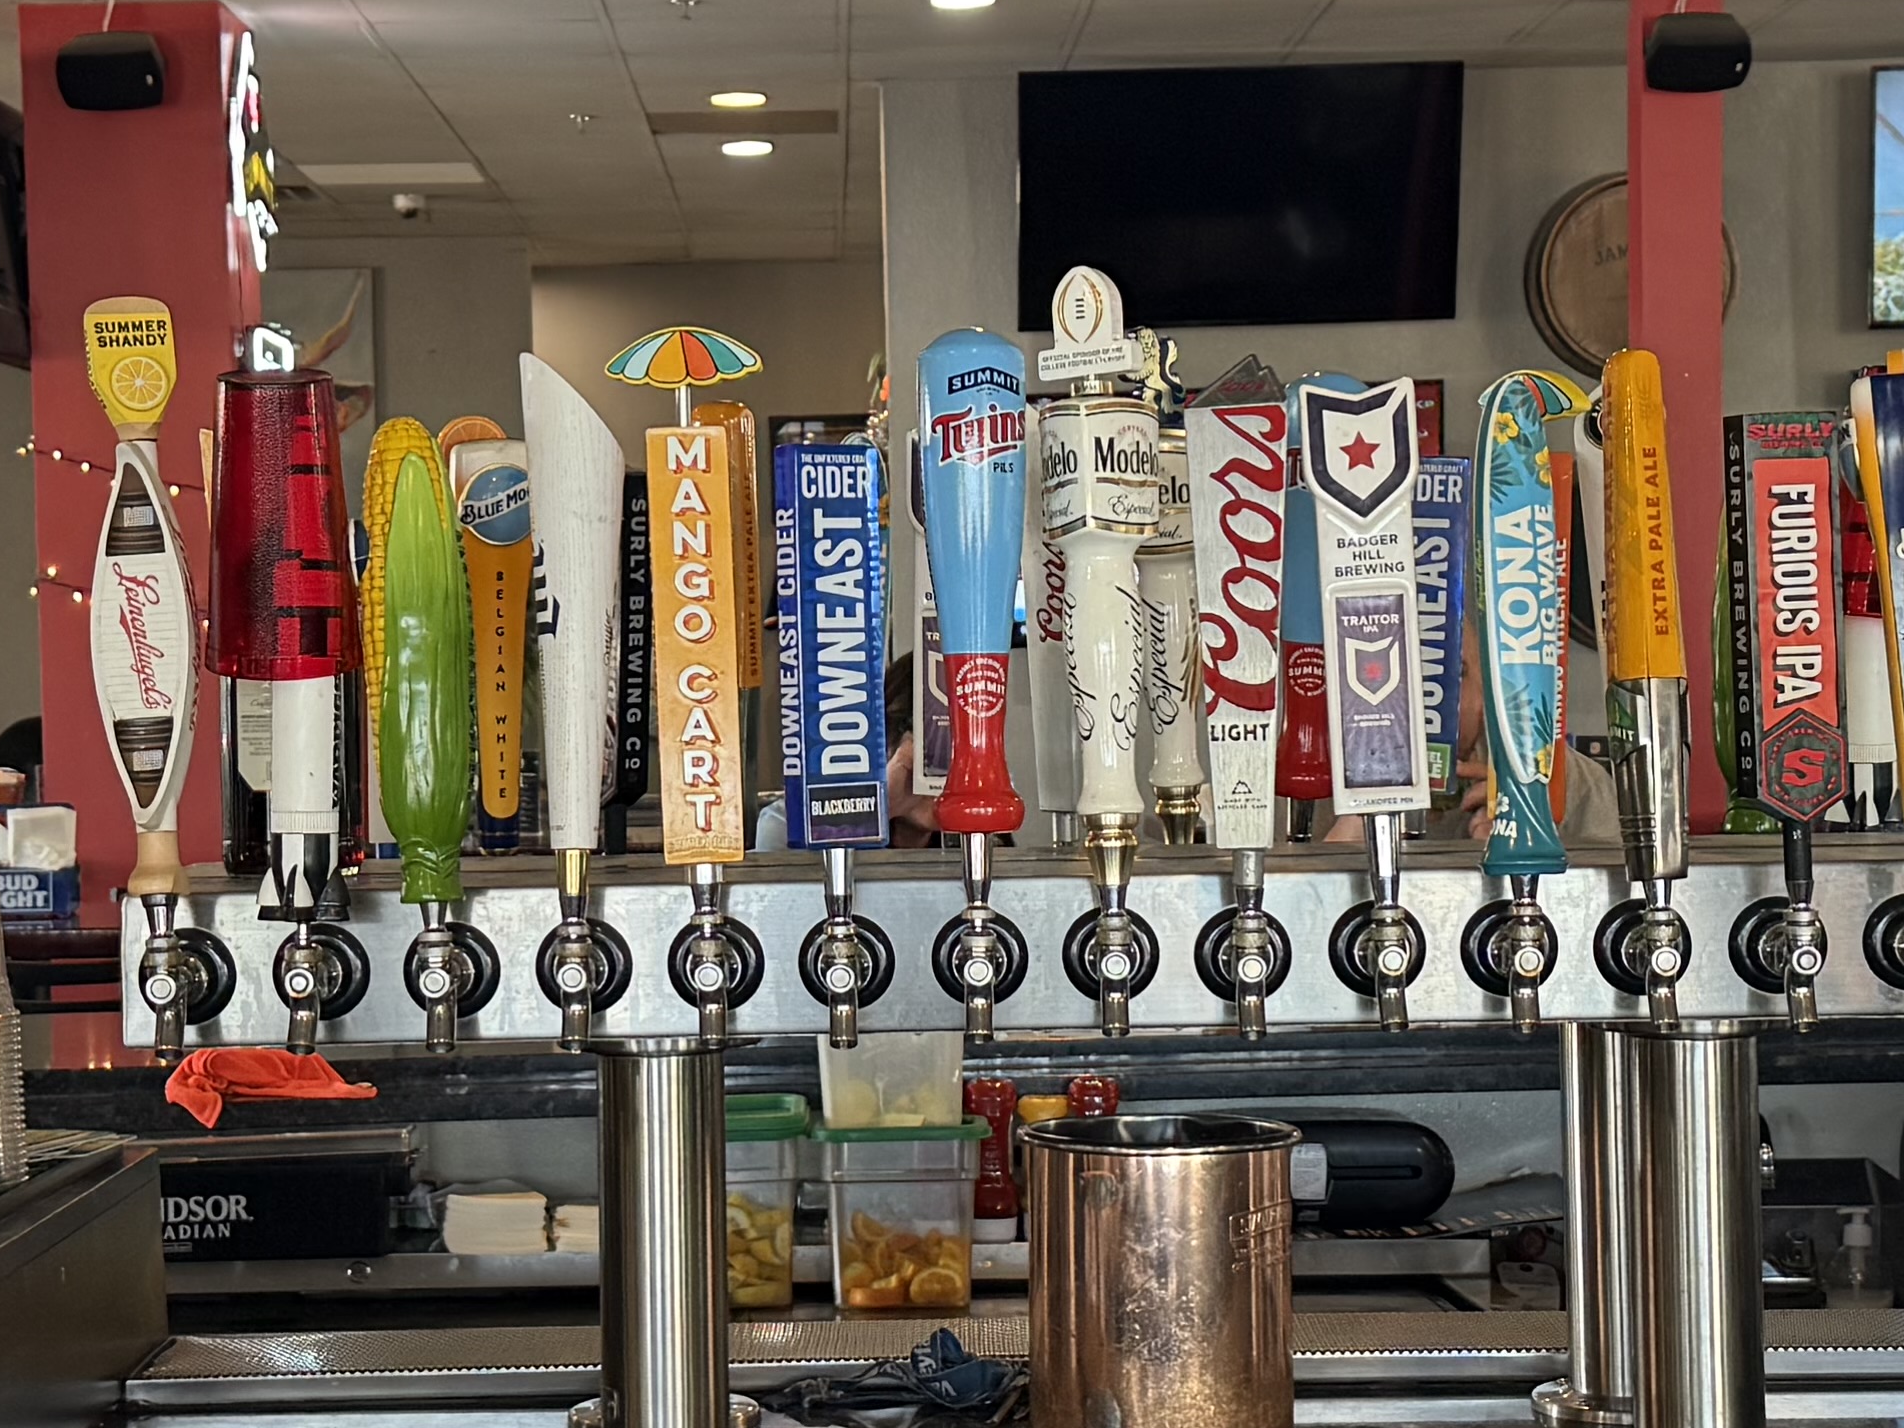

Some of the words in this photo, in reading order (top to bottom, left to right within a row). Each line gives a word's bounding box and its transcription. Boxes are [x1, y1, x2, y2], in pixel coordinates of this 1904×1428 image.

[93, 319, 168, 335] SUMMER
[97, 333, 168, 348] SHANDY
[952, 370, 1018, 390] SUMMIT
[931, 403, 1026, 462] Twins
[1094, 436, 1160, 477] Modelo
[1747, 420, 1836, 440] SURLY
[800, 464, 871, 501] CIDER
[1642, 446, 1658, 488] ALE
[1728, 445, 1743, 545] SURLY
[461, 499, 504, 524] BLUE
[666, 435, 716, 642] MANGO
[1647, 493, 1663, 553] PALE
[1199, 404, 1286, 718] Coors
[1334, 561, 1406, 578] BREWING
[1336, 533, 1400, 550] BADGER
[1351, 547, 1386, 563] HILL
[1534, 503, 1554, 606] WAVE
[1769, 483, 1821, 635] FURIOUS
[1494, 505, 1541, 665] KONA
[1648, 564, 1669, 637] EXTRA
[112, 560, 172, 712] Leinenkugel's
[496, 571, 506, 692] BELGIAN
[812, 507, 871, 776] DOWNEAST
[1341, 613, 1400, 627] TRAITOR
[1362, 625, 1380, 634] IPA
[1541, 612, 1556, 666] BIG
[1734, 560, 1749, 715] BREWING
[1776, 644, 1823, 706] IPA
[496, 714, 507, 798] WHITE
[677, 665, 720, 830] CART
[1209, 722, 1271, 744] LIGHT
[810, 793, 876, 819] BLACKBERRY
